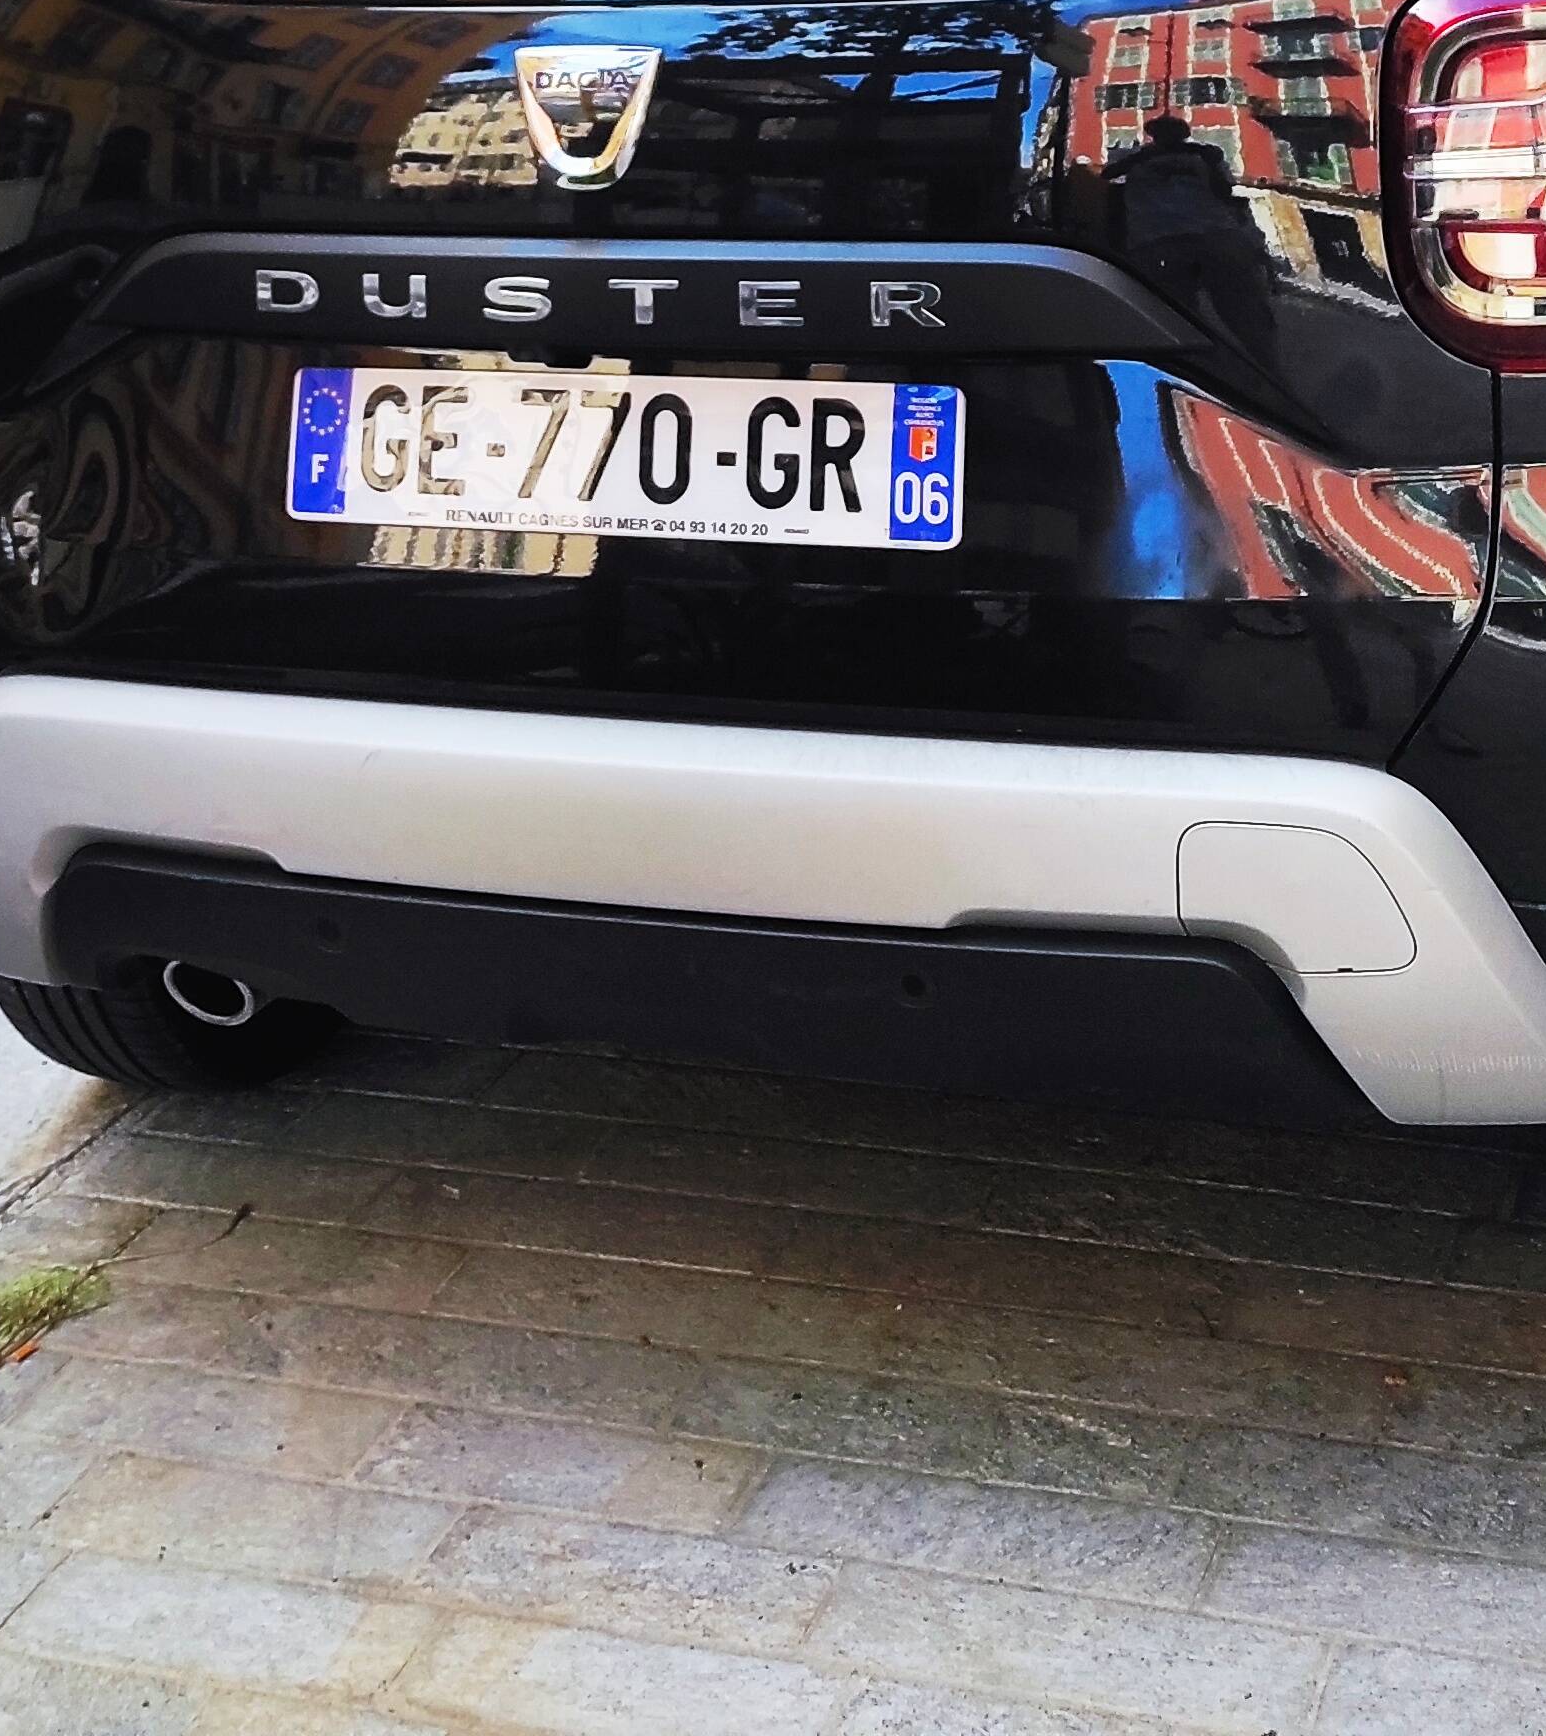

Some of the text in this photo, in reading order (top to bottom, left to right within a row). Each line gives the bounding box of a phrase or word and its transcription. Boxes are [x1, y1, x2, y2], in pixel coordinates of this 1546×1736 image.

[255, 269, 947, 328] DUSTER
[311, 452, 330, 484] F
[894, 471, 949, 526] 06
[445, 509, 514, 526] RENAULT
[518, 512, 579, 528] CAGNES
[582, 514, 613, 530] SUR
[616, 516, 649, 531] MER
[669, 520, 685, 533] 04
[689, 521, 706, 534] 93
[711, 521, 727, 535] 14
[730, 522, 748, 536] 20
[751, 523, 769, 536] 20
